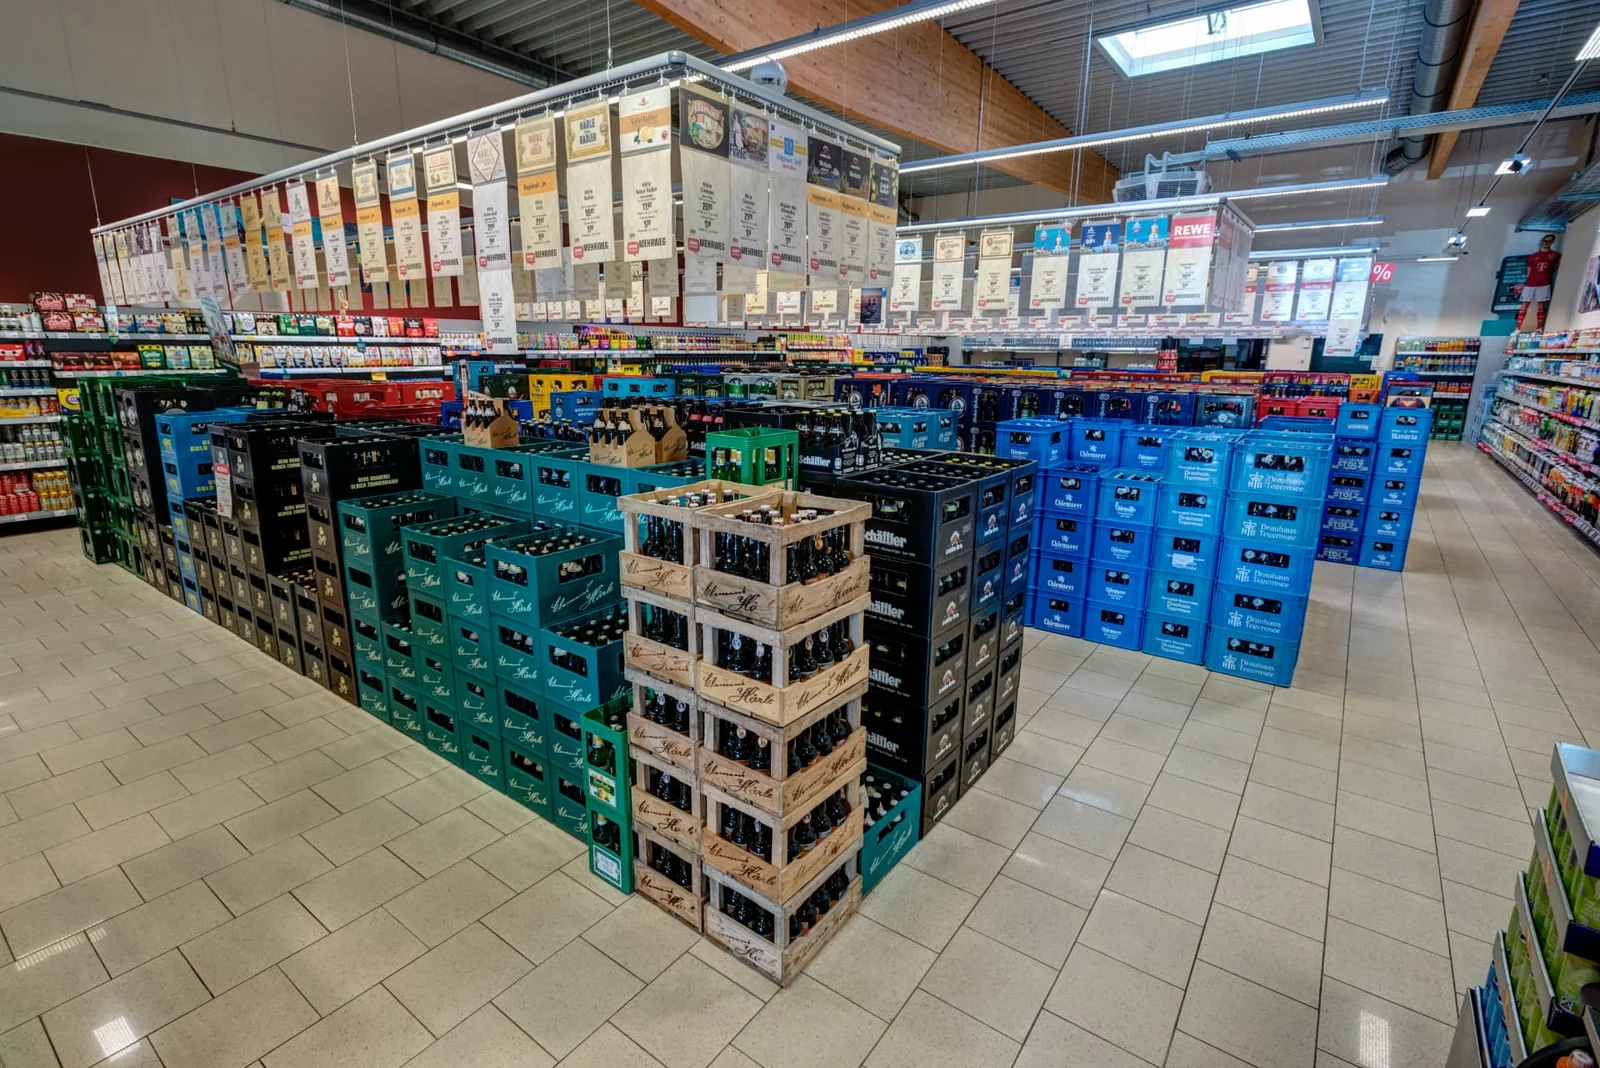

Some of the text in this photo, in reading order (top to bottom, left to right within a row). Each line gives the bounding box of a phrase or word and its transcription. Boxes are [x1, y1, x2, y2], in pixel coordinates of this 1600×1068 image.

[579, 118, 596, 130] HÄRLE
[579, 132, 597, 144] RADLER
[1174, 223, 1211, 236] REWE
[584, 241, 609, 252] MEHRWEG
[639, 237, 666, 248] MEHRWEG
[699, 239, 725, 251] MEHRWEG
[535, 249, 557, 259] MEHRWEG
[741, 246, 764, 257] MEHRWEG
[780, 252, 802, 264] MEHRWEG
[1373, 264, 1392, 281] %
[492, 336, 512, 345] MEHRWEG
[1079, 450, 1106, 459] Chiemseer
[1338, 461, 1364, 469] STOLZ
[1267, 476, 1304, 486] Brauhaus
[1266, 483, 1304, 493] Tegernsee
[1055, 499, 1083, 510] Chiemseer
[1261, 523, 1297, 535] Brauhaus
[864, 529, 907, 548] chäffler
[1260, 530, 1296, 541] Tegernsee
[1051, 540, 1078, 551] Chiemseer
[1323, 550, 1349, 558] STOLZ
[1254, 569, 1290, 581] Brauhaus
[1047, 580, 1075, 591] Chiemseer
[1253, 577, 1290, 588] Tegernsee
[1043, 618, 1070, 630] Chiemseer
[1246, 615, 1282, 628] Brauhaus
[1245, 622, 1281, 634] Tegernsee
[1240, 658, 1275, 671] Brauhaus
[1239, 665, 1275, 678] Tegernsee
[728, 686, 774, 705] Härle
[865, 732, 899, 753] häffler
